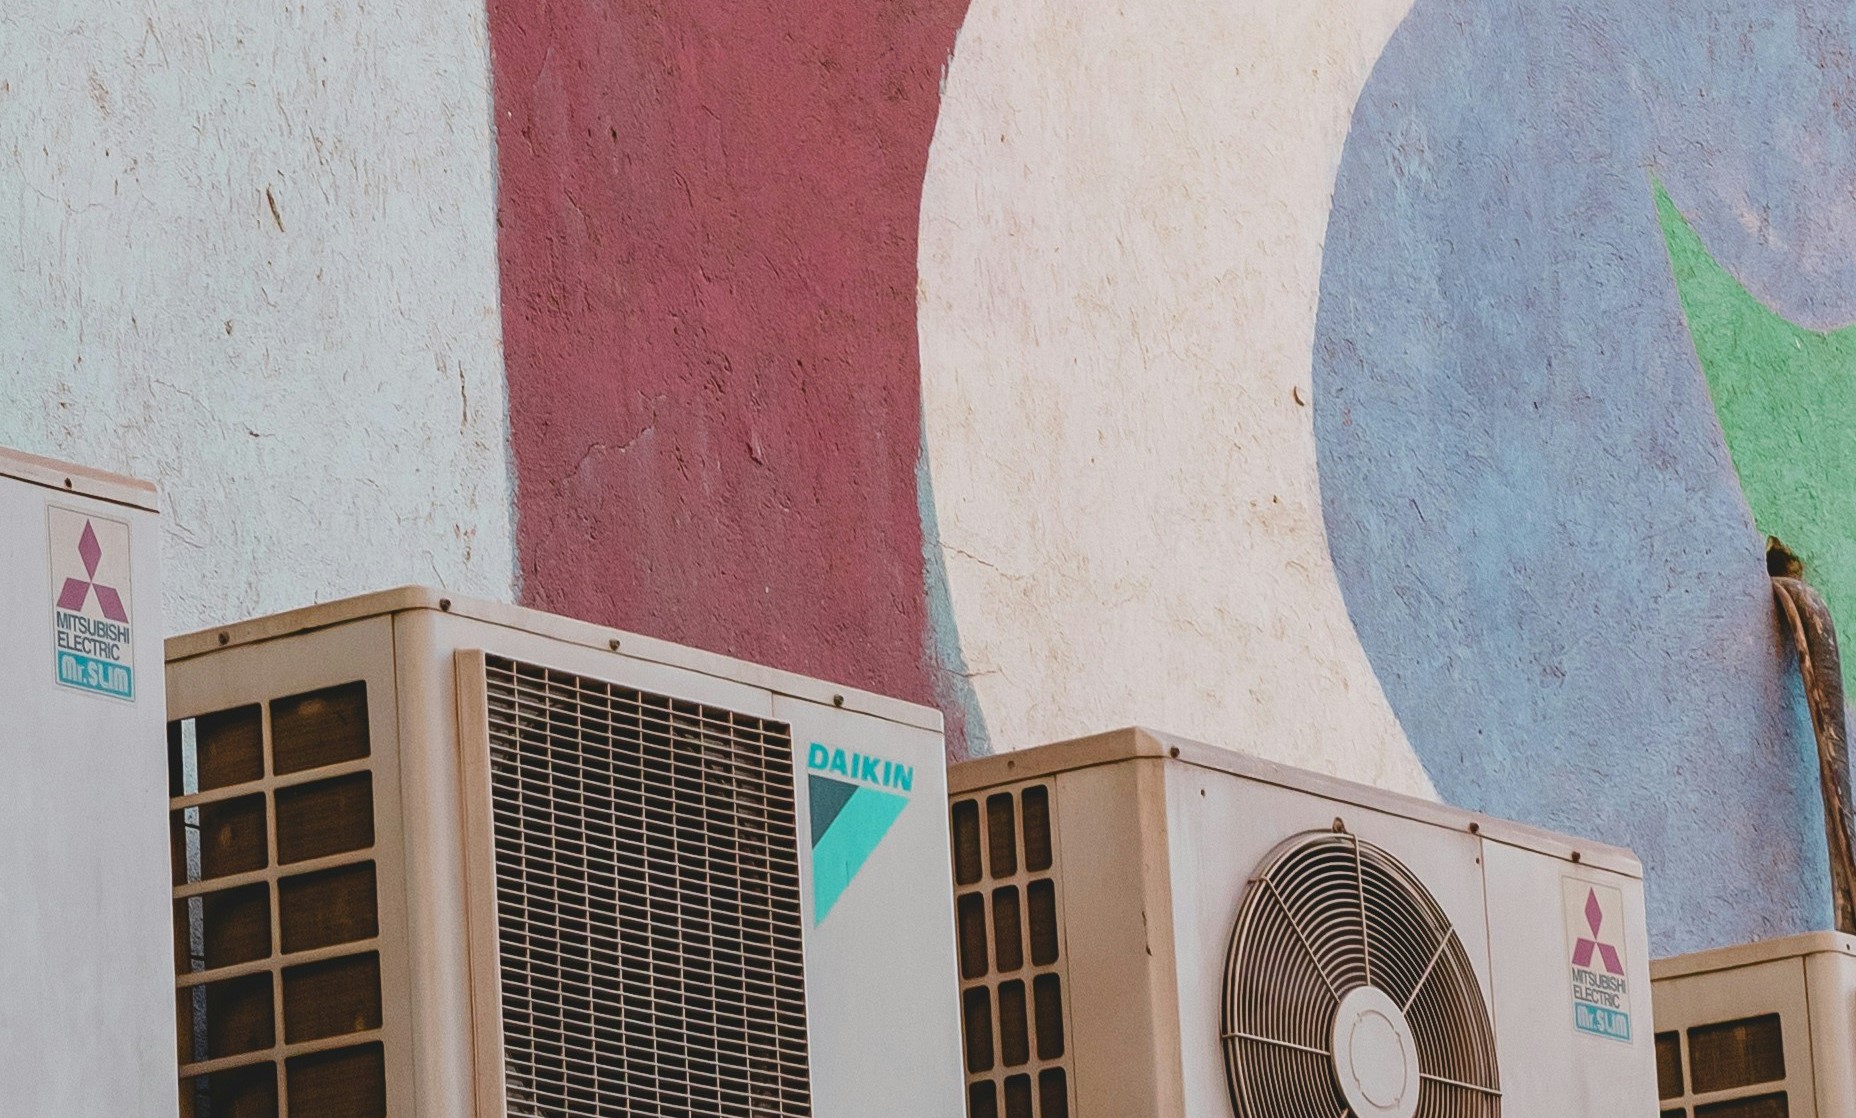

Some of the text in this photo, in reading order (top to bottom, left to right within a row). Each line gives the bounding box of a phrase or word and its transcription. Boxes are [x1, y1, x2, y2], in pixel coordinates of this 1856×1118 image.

[56, 610, 130, 645] MITSUBISHI
[57, 629, 120, 661] ELECTRIC
[807, 742, 914, 792] DAIKIN
[1571, 967, 1626, 994] MITSUBISHI
[1573, 984, 1620, 1009] ELECTRIC
